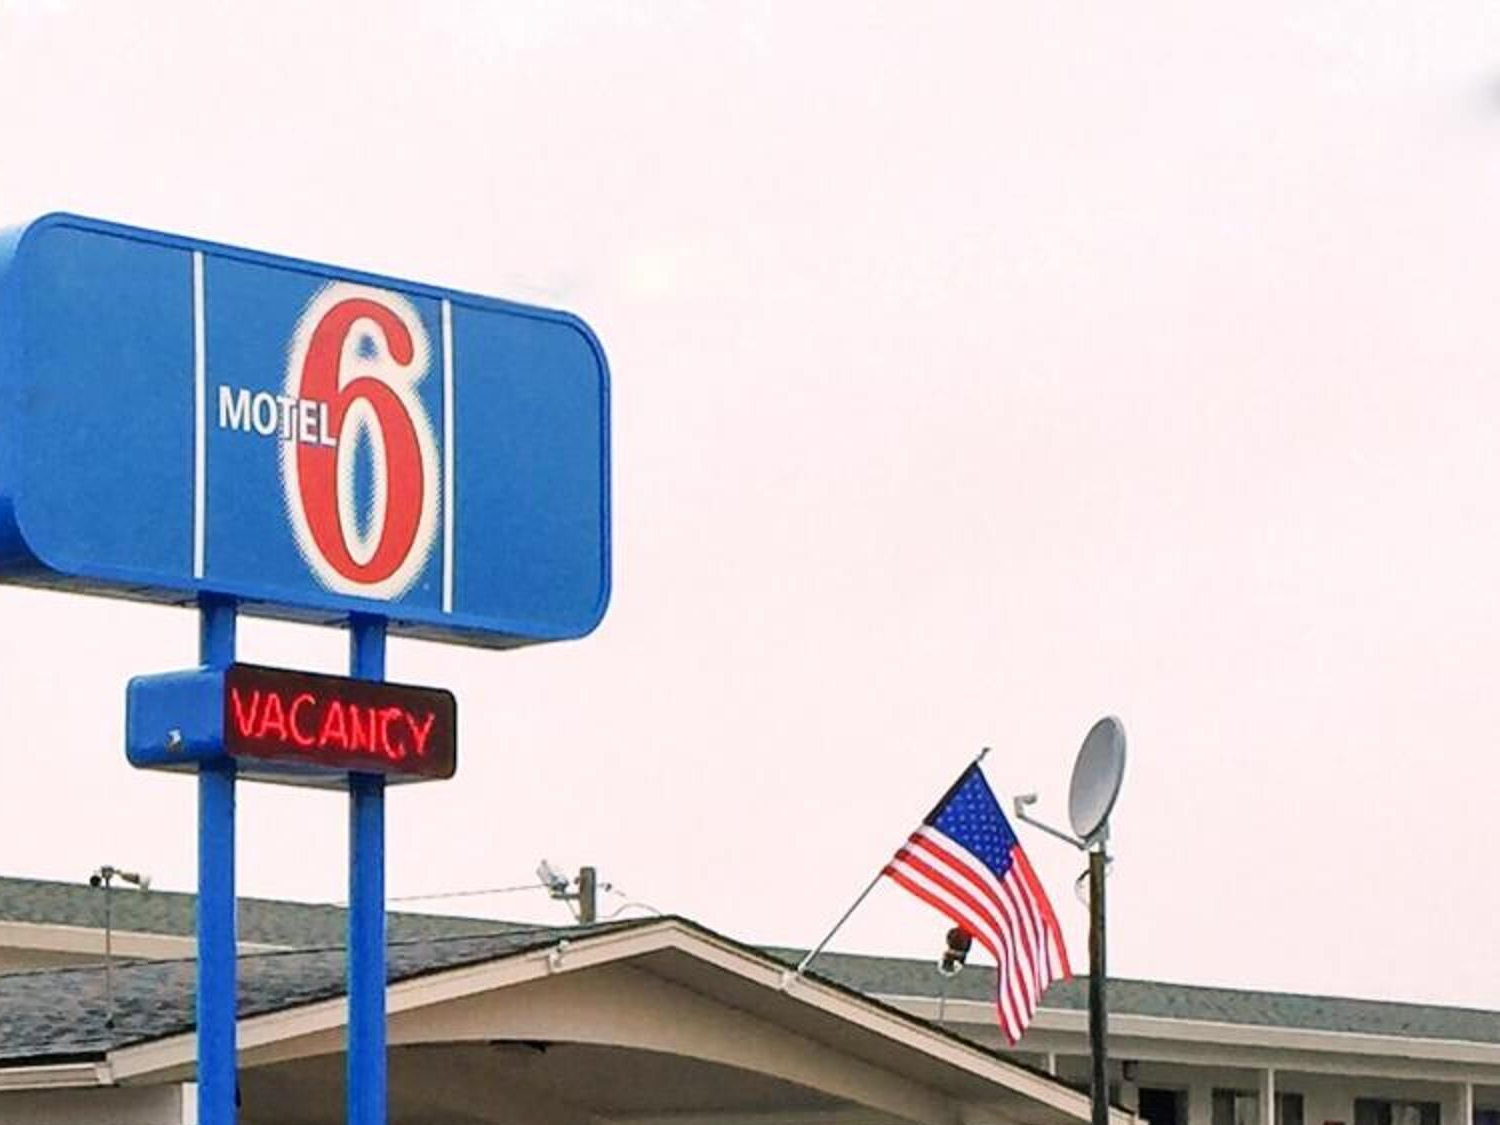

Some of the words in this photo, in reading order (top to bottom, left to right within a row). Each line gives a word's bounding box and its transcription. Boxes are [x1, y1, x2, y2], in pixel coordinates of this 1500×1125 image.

[219, 385, 338, 447] MOTEL
[295, 295, 426, 587] 6
[231, 687, 436, 760] VACANCY
